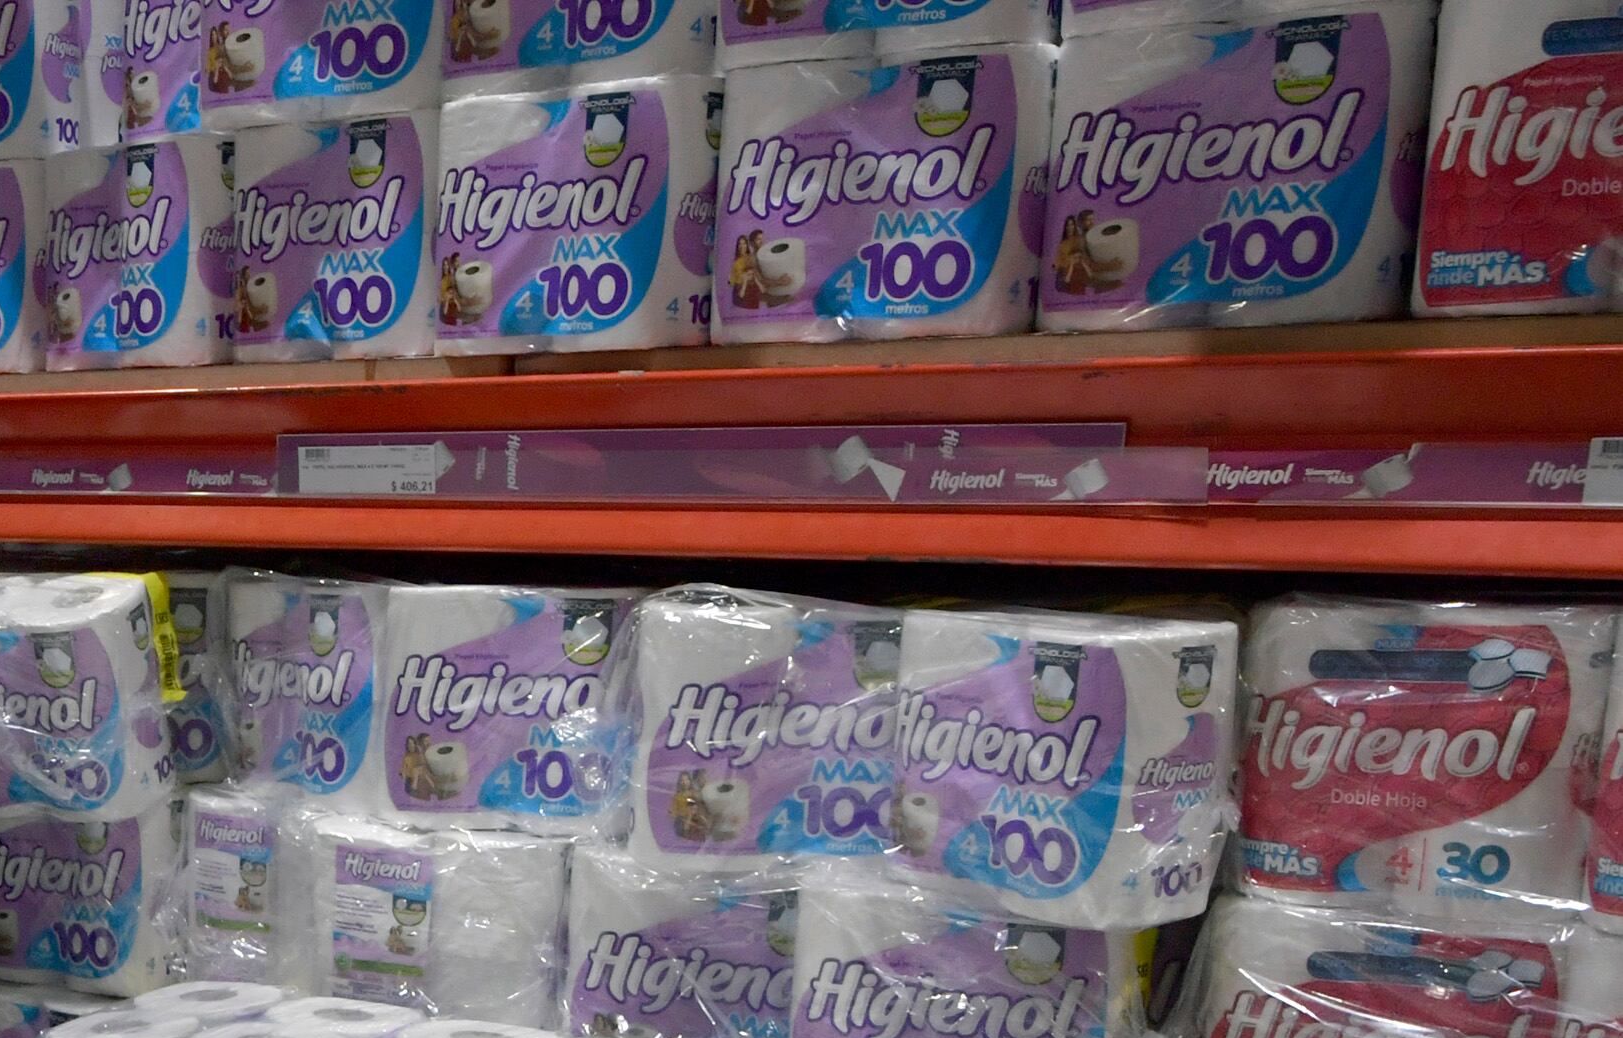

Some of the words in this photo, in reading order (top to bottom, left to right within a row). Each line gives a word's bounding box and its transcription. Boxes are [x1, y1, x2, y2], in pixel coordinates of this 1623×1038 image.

[323, 0, 382, 25] MAX
[561, 0, 652, 49] 100
[897, 7, 946, 23] metros
[535, 23, 554, 42] 4
[311, 24, 408, 81] 100
[288, 60, 303, 77] 4
[1057, 90, 1362, 204] Higienol
[728, 126, 994, 227] Higienol
[1562, 179, 1621, 196] Doble
[439, 158, 645, 249] Higienol
[1225, 182, 1323, 217] MAX
[236, 176, 401, 263] Higienol
[874, 210, 960, 238] MAX
[47, 198, 168, 292] Higienol
[553, 235, 620, 262] MAX
[1200, 216, 1334, 285] 100
[321, 249, 385, 275] MAX
[860, 240, 974, 301] 100
[1169, 252, 1193, 278] 4
[1427, 266, 1474, 286] rinde
[1477, 256, 1546, 286] MÁS
[1431, 252, 1508, 268] Siempre
[536, 264, 630, 318] 100
[835, 272, 855, 294] 4
[1232, 283, 1284, 298] metros
[313, 277, 395, 327] 100
[515, 290, 532, 312] 4
[885, 302, 928, 315] metros
[506, 433, 520, 491] Higienol
[32, 469, 74, 486] Higienol
[186, 469, 234, 489] Higienol
[391, 481, 396, 492] $
[930, 469, 1005, 494] Higienol
[1207, 463, 1294, 490] Higienol
[398, 652, 606, 732] Higieno
[667, 684, 898, 766] Higieno
[894, 691, 1102, 789] Higienol
[1248, 699, 1536, 790] Higienol
[494, 770, 512, 793] 4
[992, 786, 1071, 823] MAX
[1330, 787, 1380, 806] Doble
[1385, 791, 1427, 810] Hoja
[199, 818, 265, 847] Higienol
[774, 808, 791, 830] 4
[982, 815, 1079, 886] 100
[1262, 849, 1319, 876] MÁS
[1385, 847, 1414, 875] 4
[1443, 842, 1511, 885] 30
[344, 853, 422, 882] Higienol
[50, 922, 118, 969] 100
